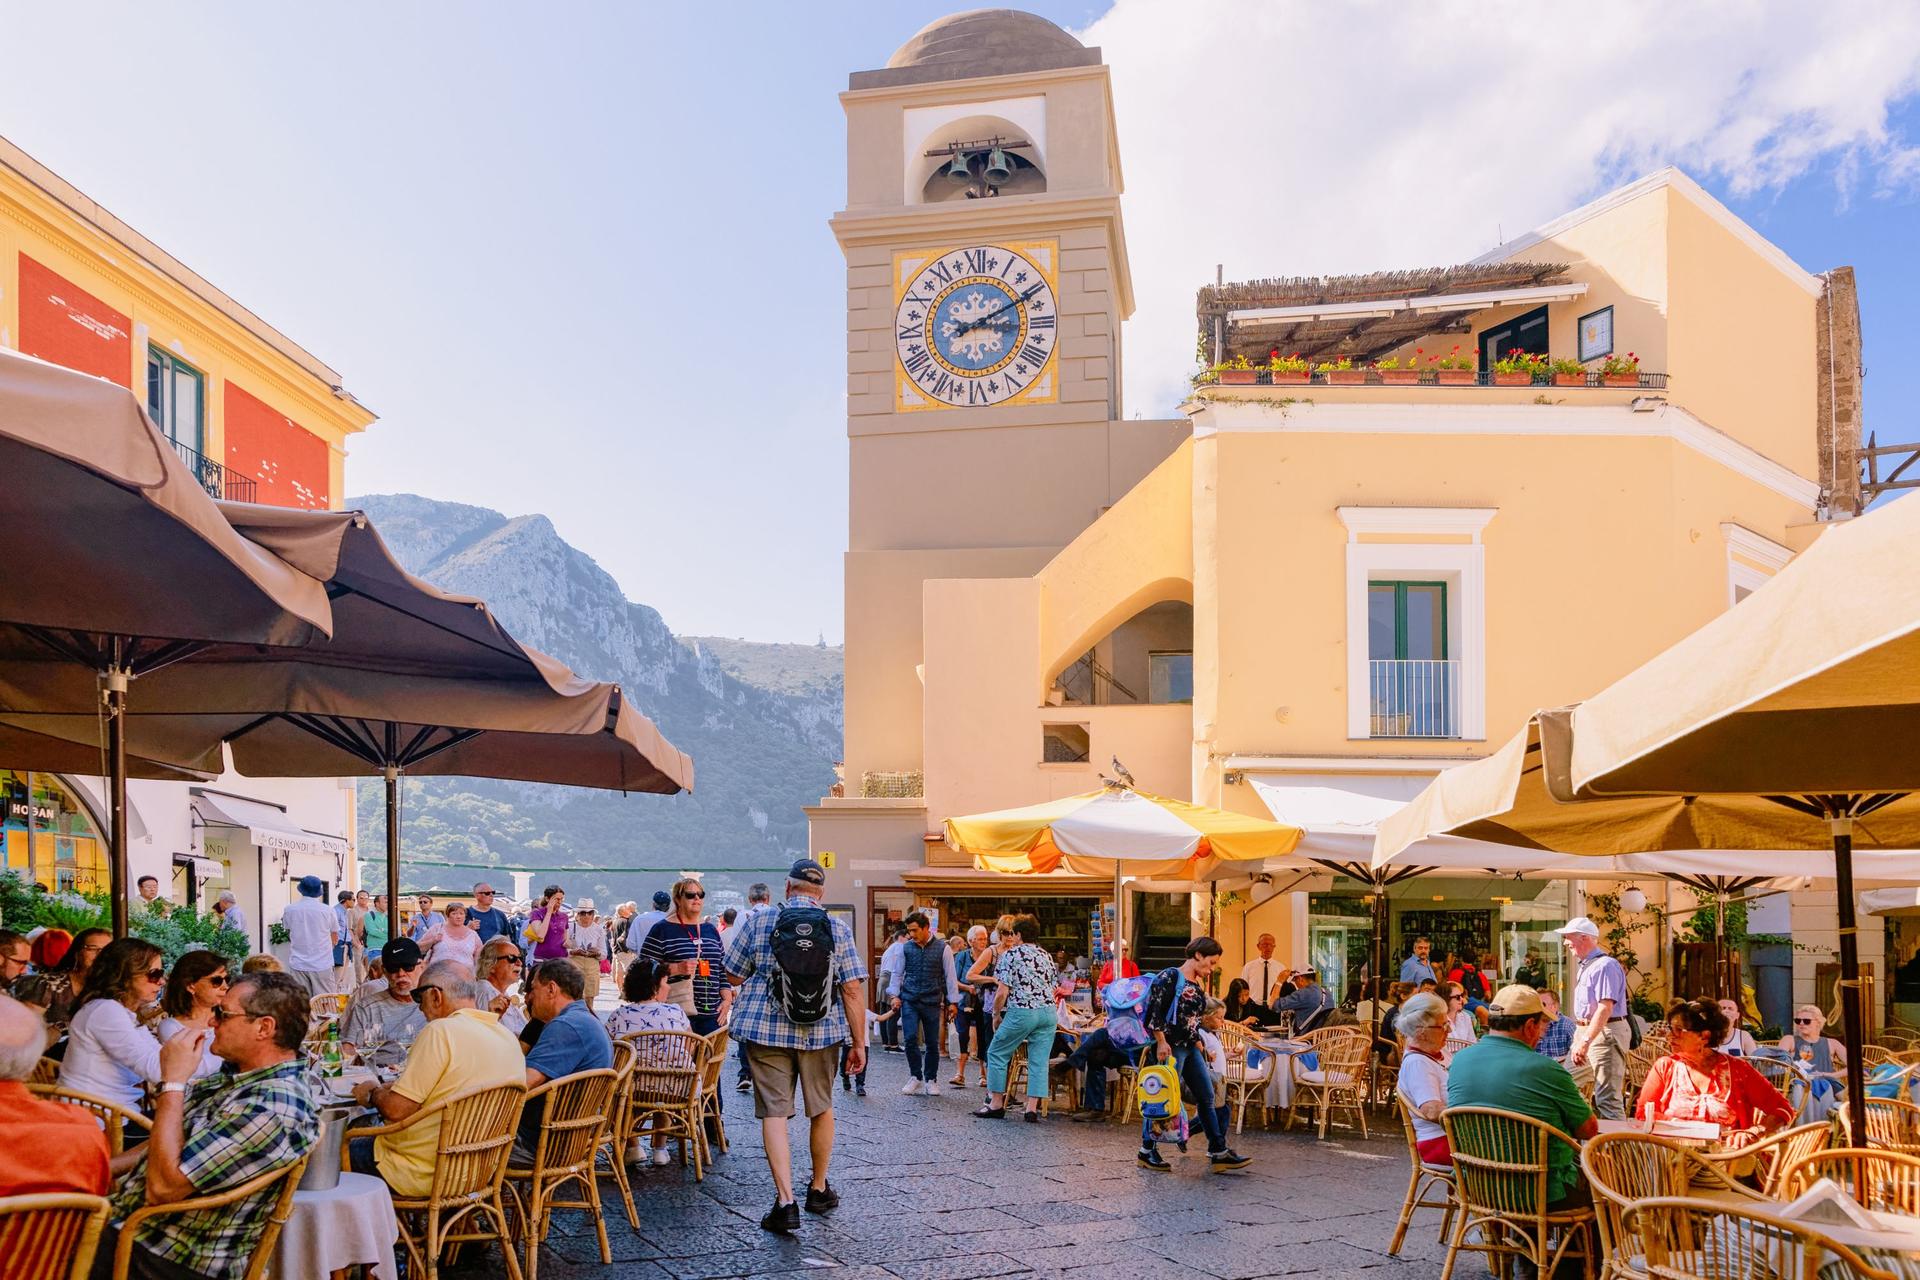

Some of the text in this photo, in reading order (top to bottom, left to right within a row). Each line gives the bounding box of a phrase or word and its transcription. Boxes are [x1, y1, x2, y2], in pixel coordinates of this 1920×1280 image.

[964, 249, 987, 274] XII
[1001, 255, 1017, 279] I
[928, 260, 954, 288] XI
[905, 290, 933, 310] X
[899, 322, 923, 340] IX
[1029, 315, 1055, 330] III
[1019, 343, 1049, 369] IIII
[931, 372, 955, 401] VII
[969, 380, 989, 404] VI
[1003, 372, 1024, 395] V
[268, 836, 309, 852] GISMONDI
[823, 852, 831, 868] i
